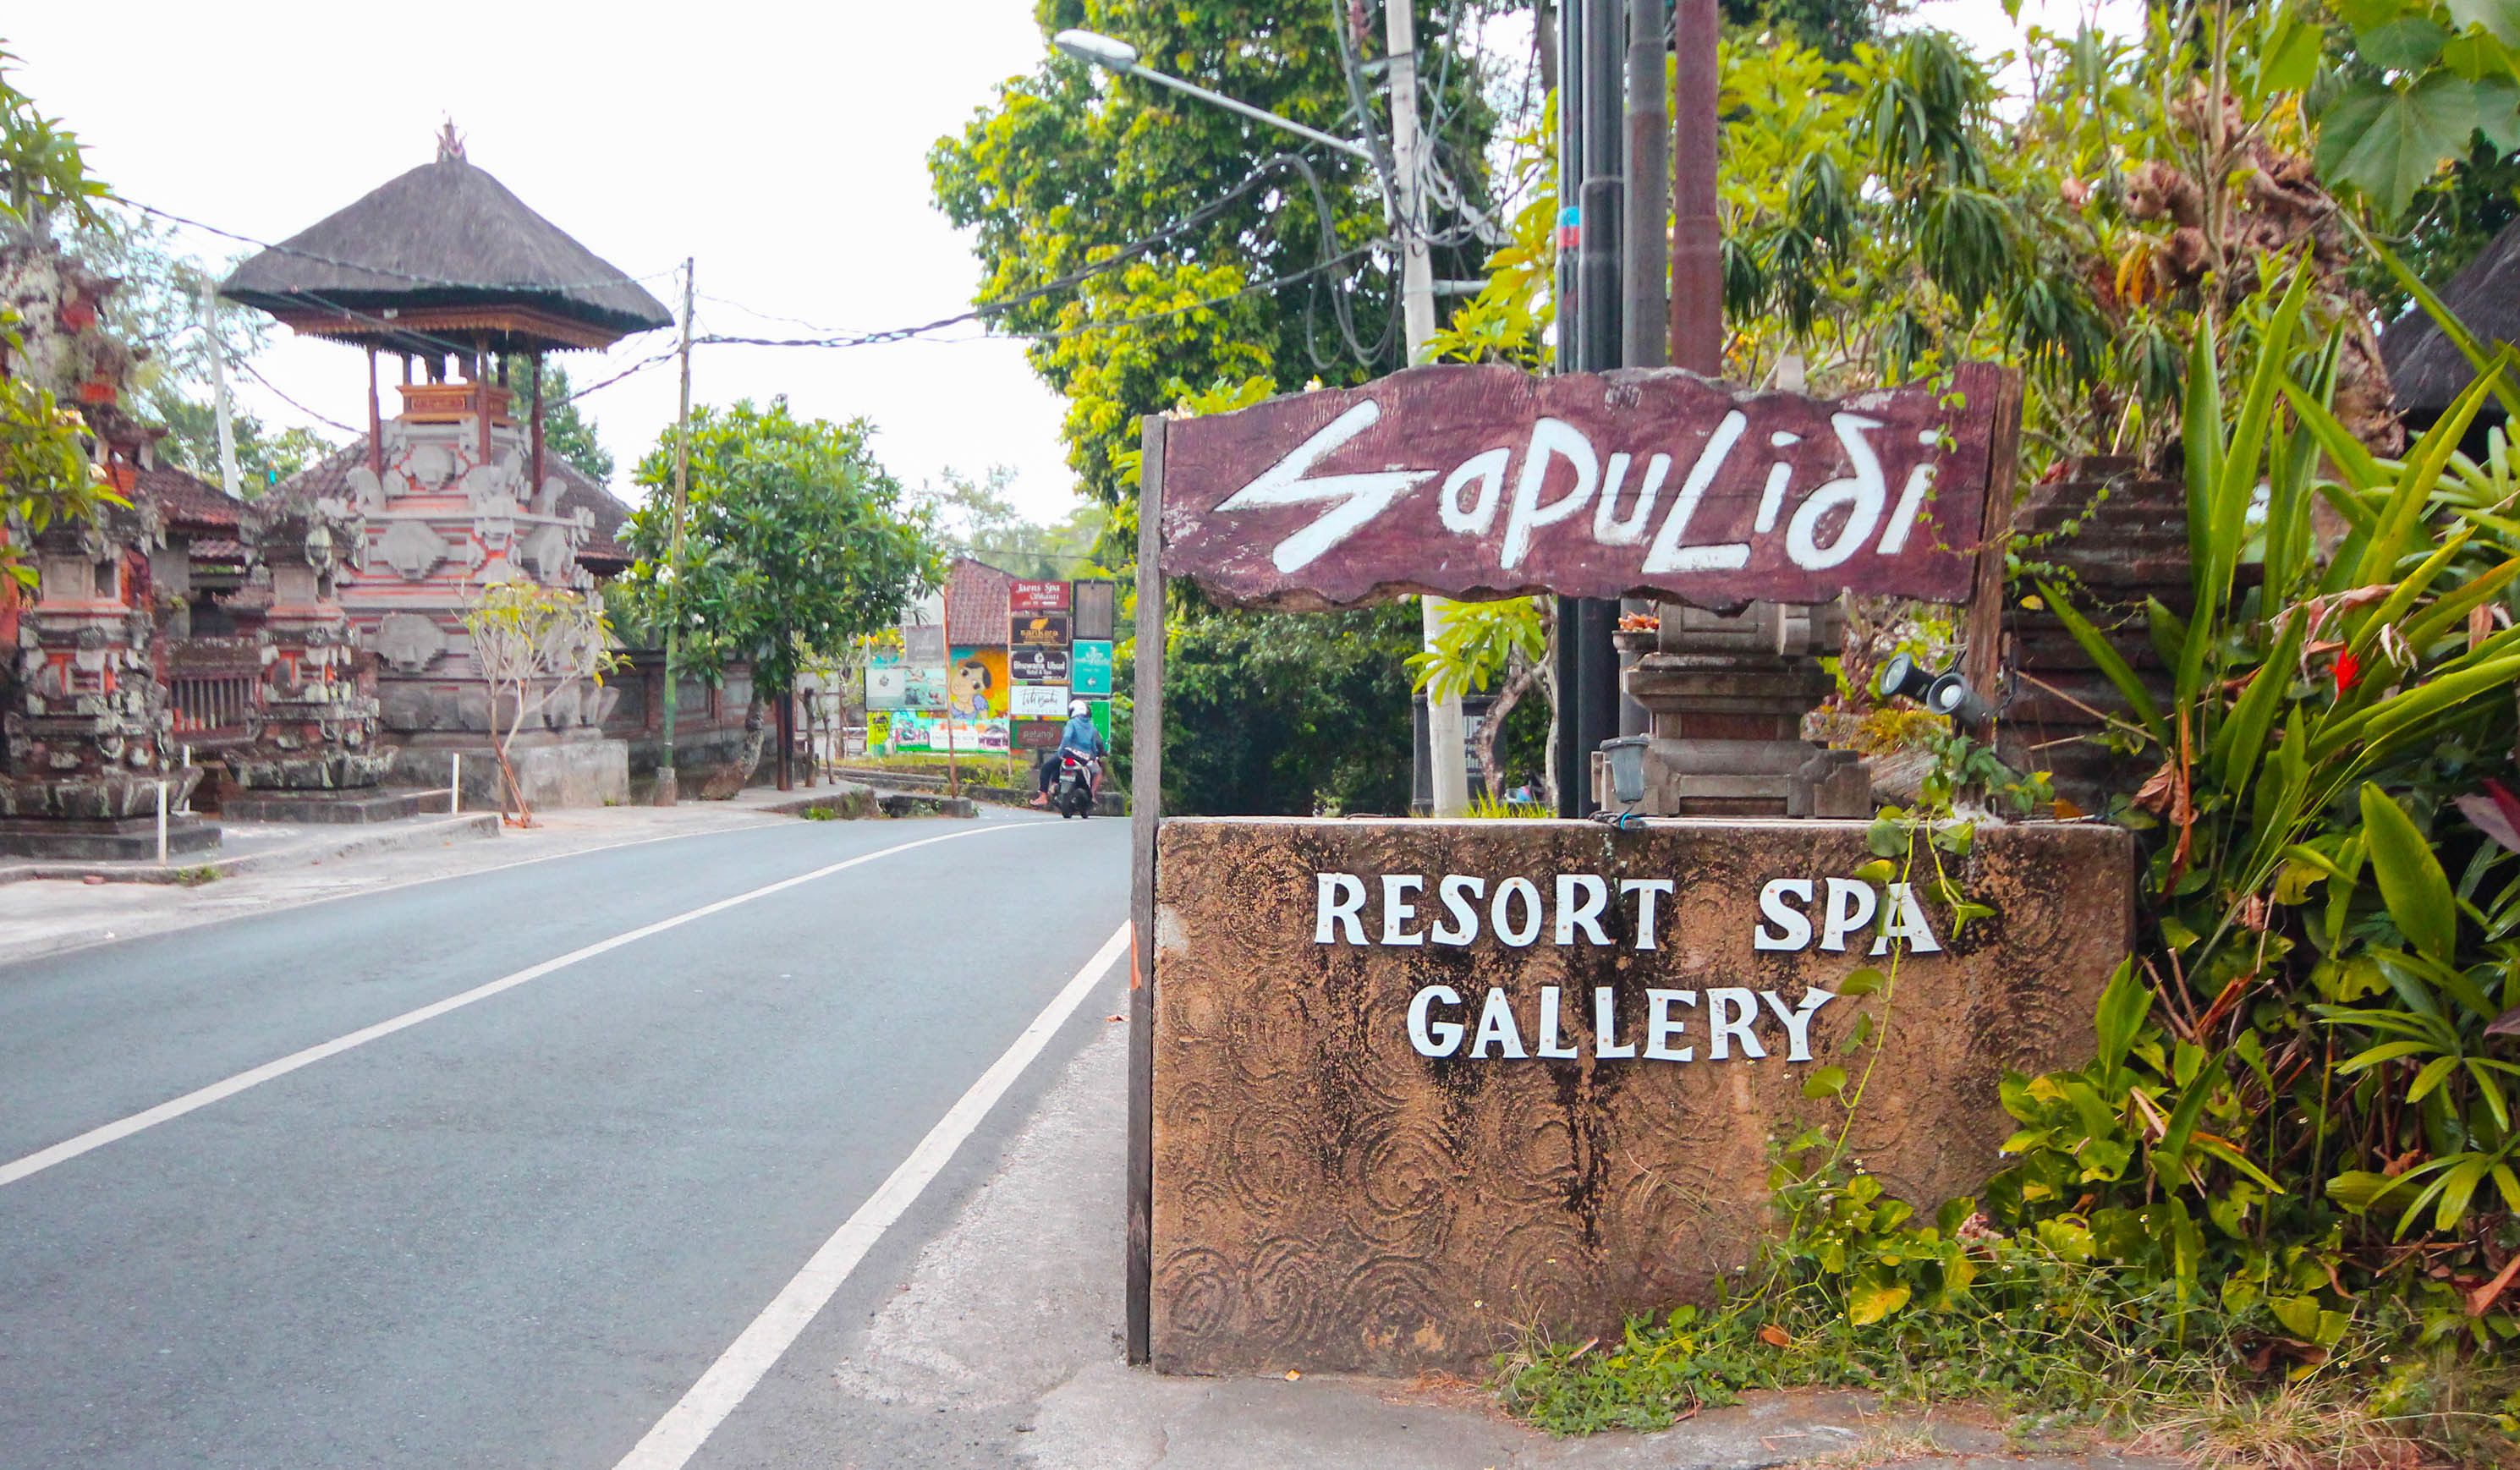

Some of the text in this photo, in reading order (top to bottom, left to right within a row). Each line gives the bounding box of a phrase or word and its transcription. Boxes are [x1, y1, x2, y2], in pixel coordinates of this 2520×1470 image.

[1044, 583, 1060, 594] Spa
[1046, 661, 1065, 670] Ubud
[1313, 872, 1945, 955] RESORT SPA
[1407, 985, 1836, 1062] GALLERY
